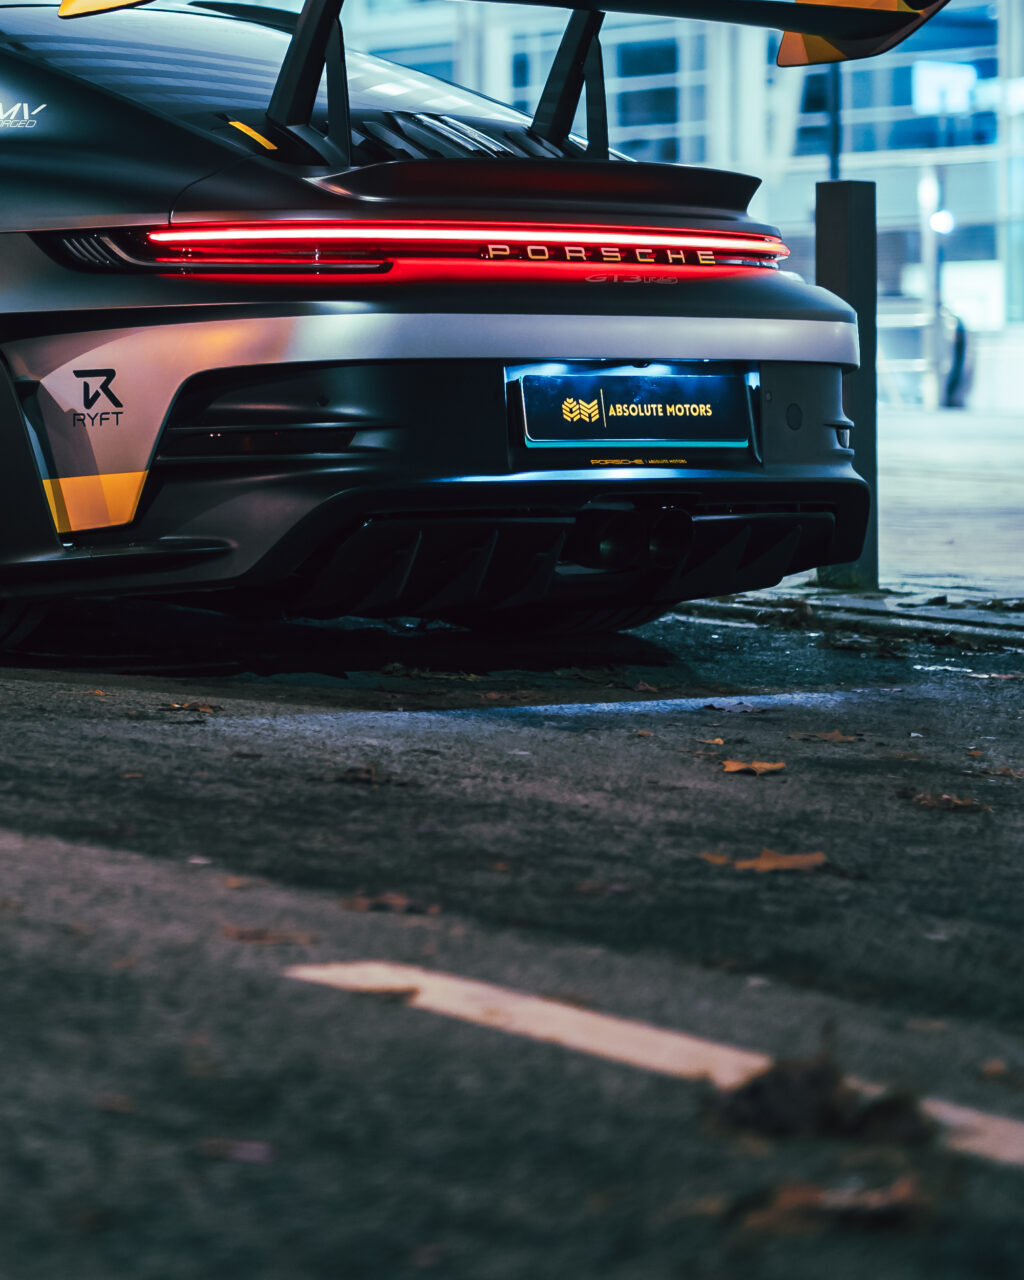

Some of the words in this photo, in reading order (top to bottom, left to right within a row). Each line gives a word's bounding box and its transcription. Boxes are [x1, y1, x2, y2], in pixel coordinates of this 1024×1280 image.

[487, 243, 716, 265] PORSCHE
[608, 403, 664, 417] ABSOLUTE
[665, 403, 713, 417] MOTORS
[72, 411, 124, 428] RYFT
